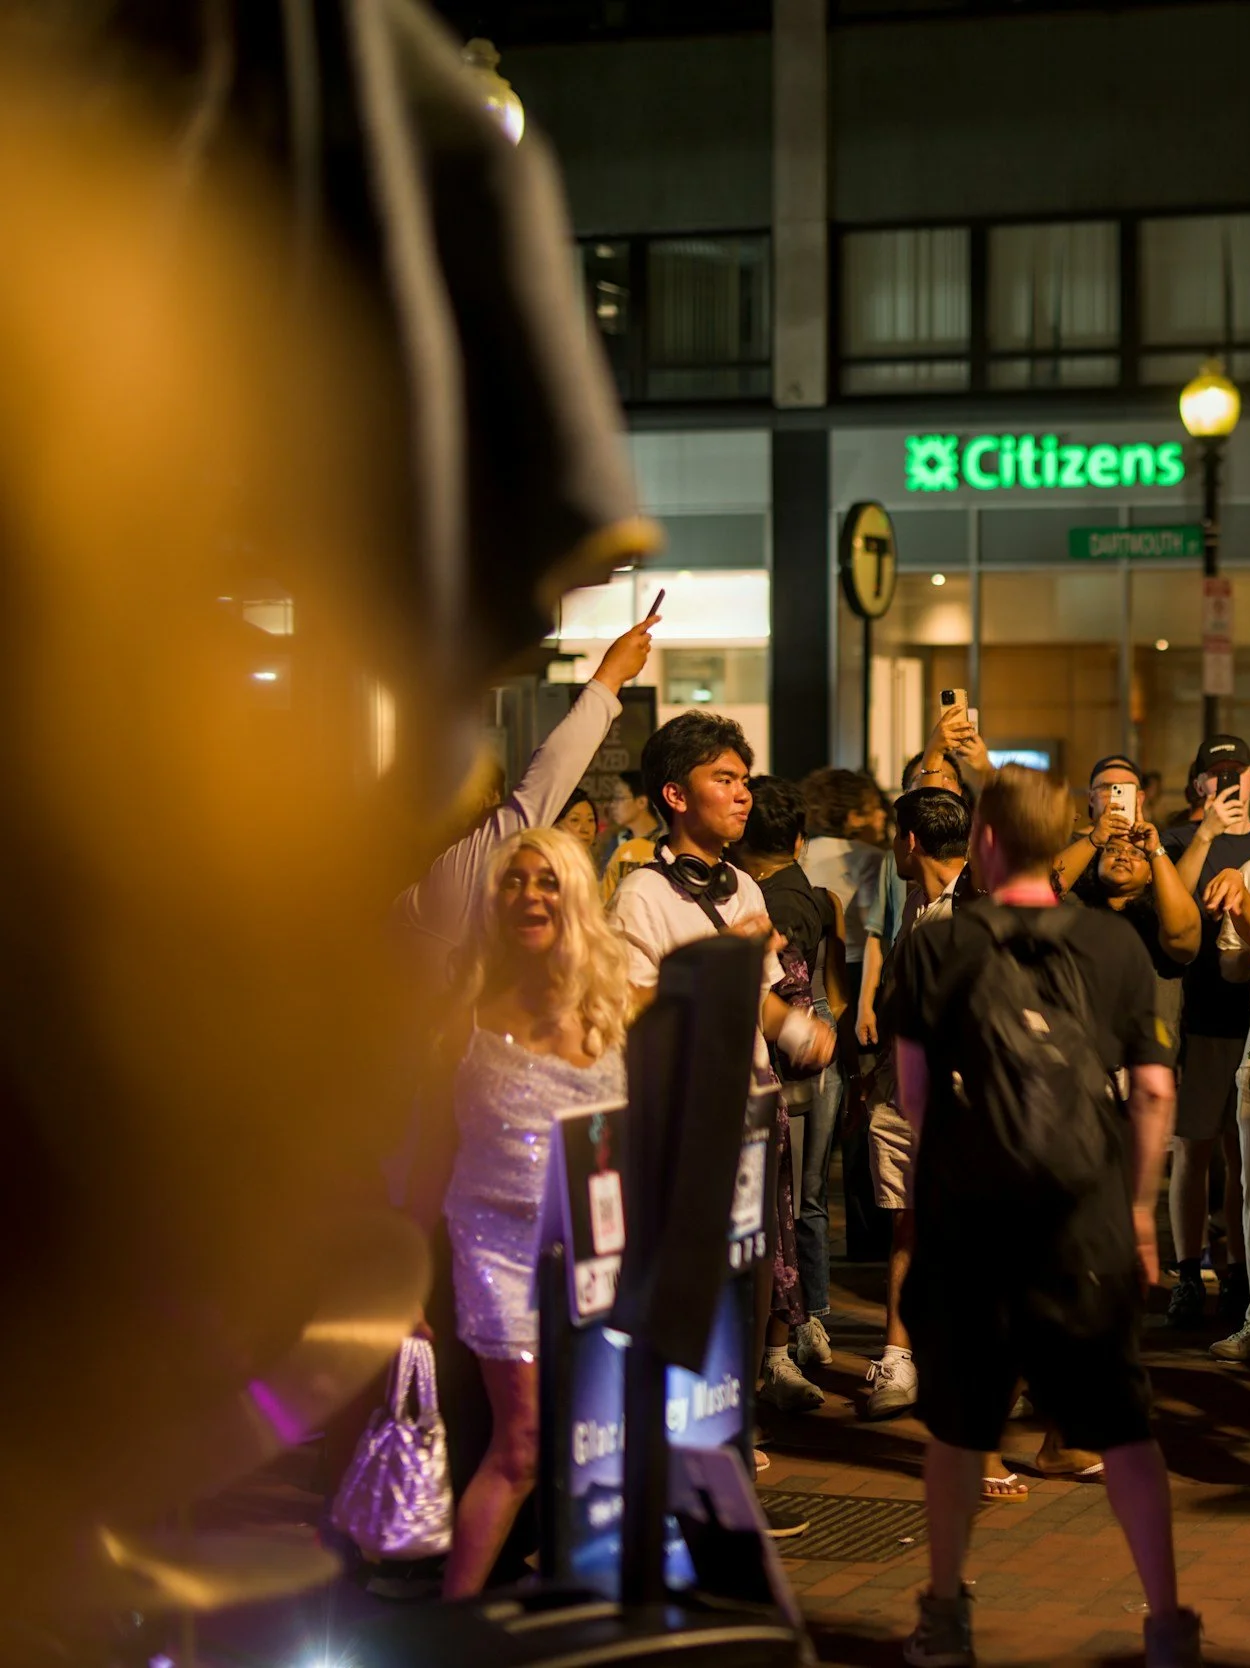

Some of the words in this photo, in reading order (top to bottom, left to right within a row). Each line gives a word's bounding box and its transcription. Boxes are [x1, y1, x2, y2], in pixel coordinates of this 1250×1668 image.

[962, 434, 1185, 490] Citizens
[863, 535, 891, 598] T
[1089, 530, 1184, 556] DARTMOUTH
